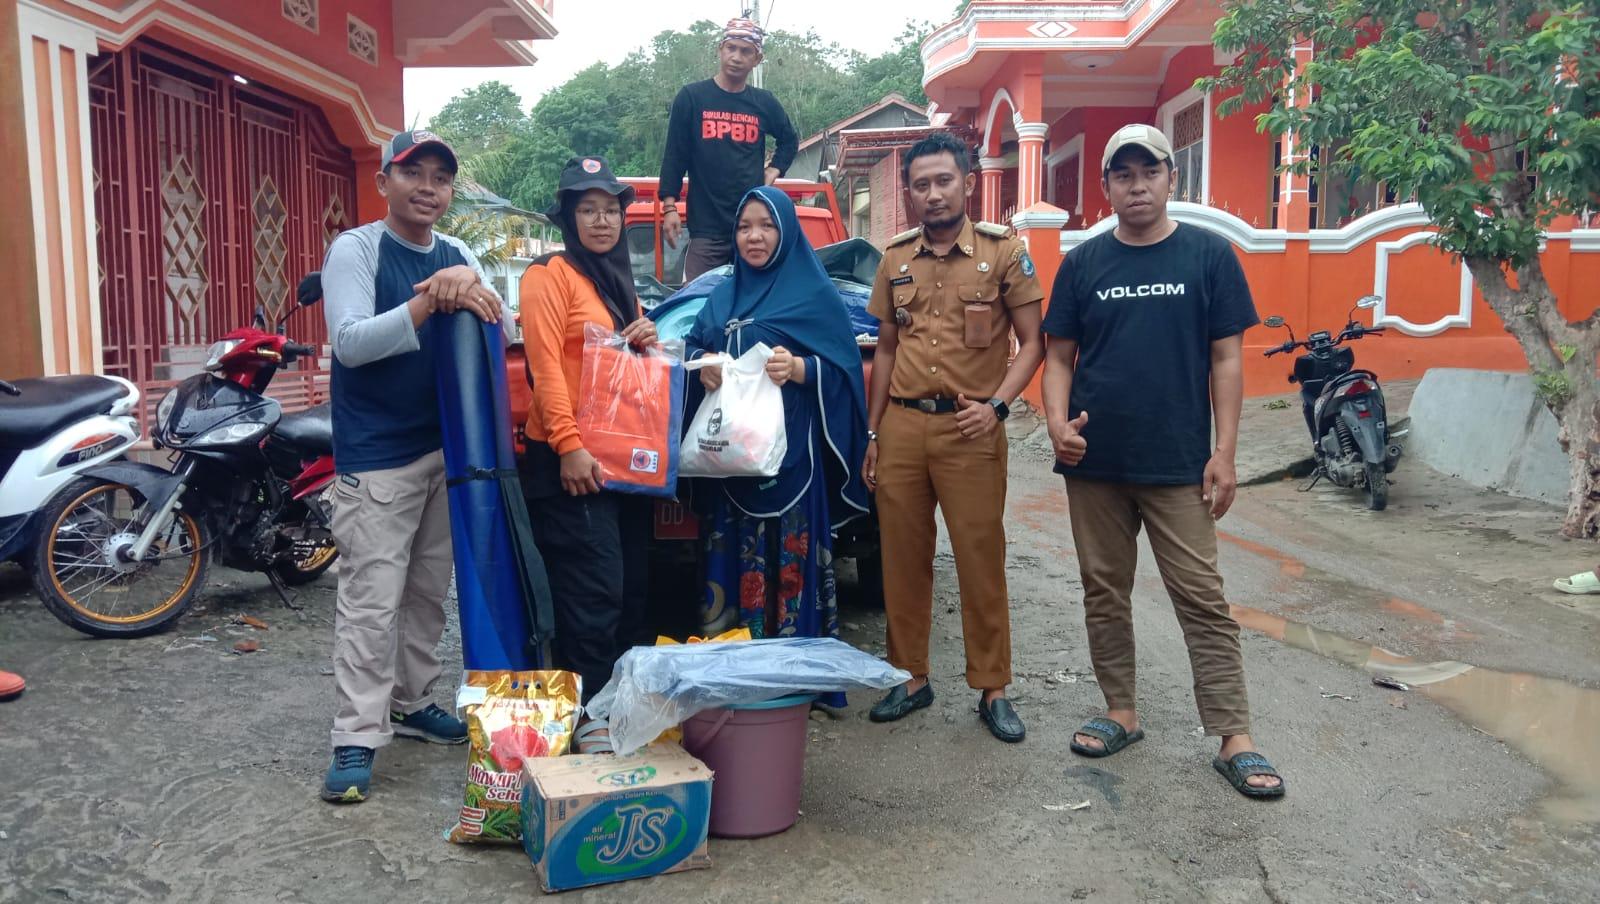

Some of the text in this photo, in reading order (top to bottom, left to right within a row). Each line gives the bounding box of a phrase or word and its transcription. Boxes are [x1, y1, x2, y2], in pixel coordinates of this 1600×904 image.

[702, 110, 731, 121] SIMULASI
[702, 120, 759, 144] BPBD
[1096, 283, 1185, 301] VOLCOM
[660, 503, 684, 525] DD
[468, 764, 517, 788] Mawar
[583, 831, 616, 844] mineral
[591, 824, 603, 834] air
[596, 803, 671, 865] JS
